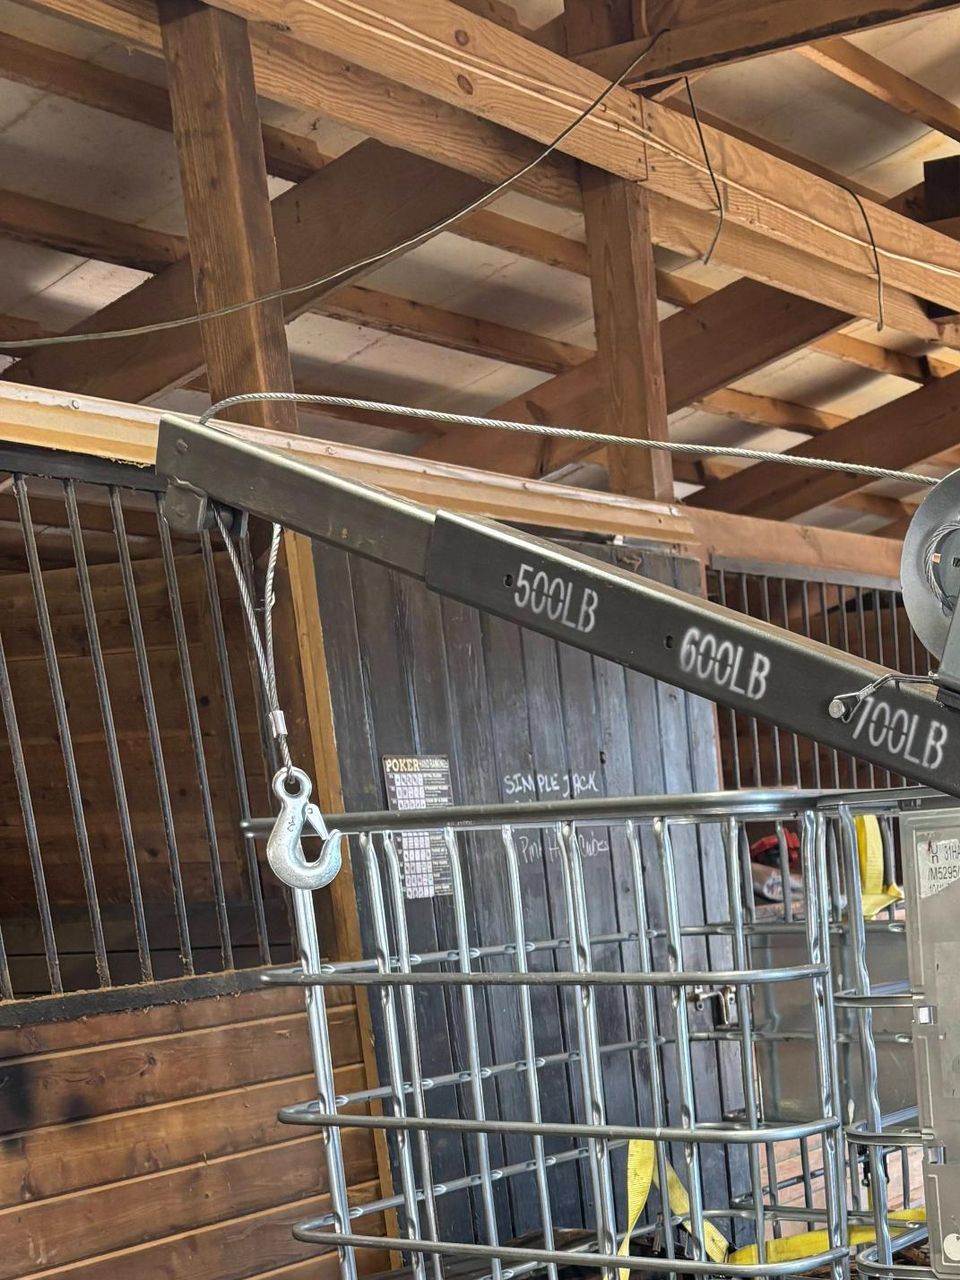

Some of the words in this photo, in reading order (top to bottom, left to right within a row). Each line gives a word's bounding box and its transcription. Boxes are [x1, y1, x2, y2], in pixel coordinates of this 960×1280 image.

[515, 563, 599, 633] 500LB
[680, 626, 771, 700] 600LB
[385, 759, 420, 772] POKER
[503, 772, 560, 794] SIMPLE
[562, 770, 600, 798] JACK
